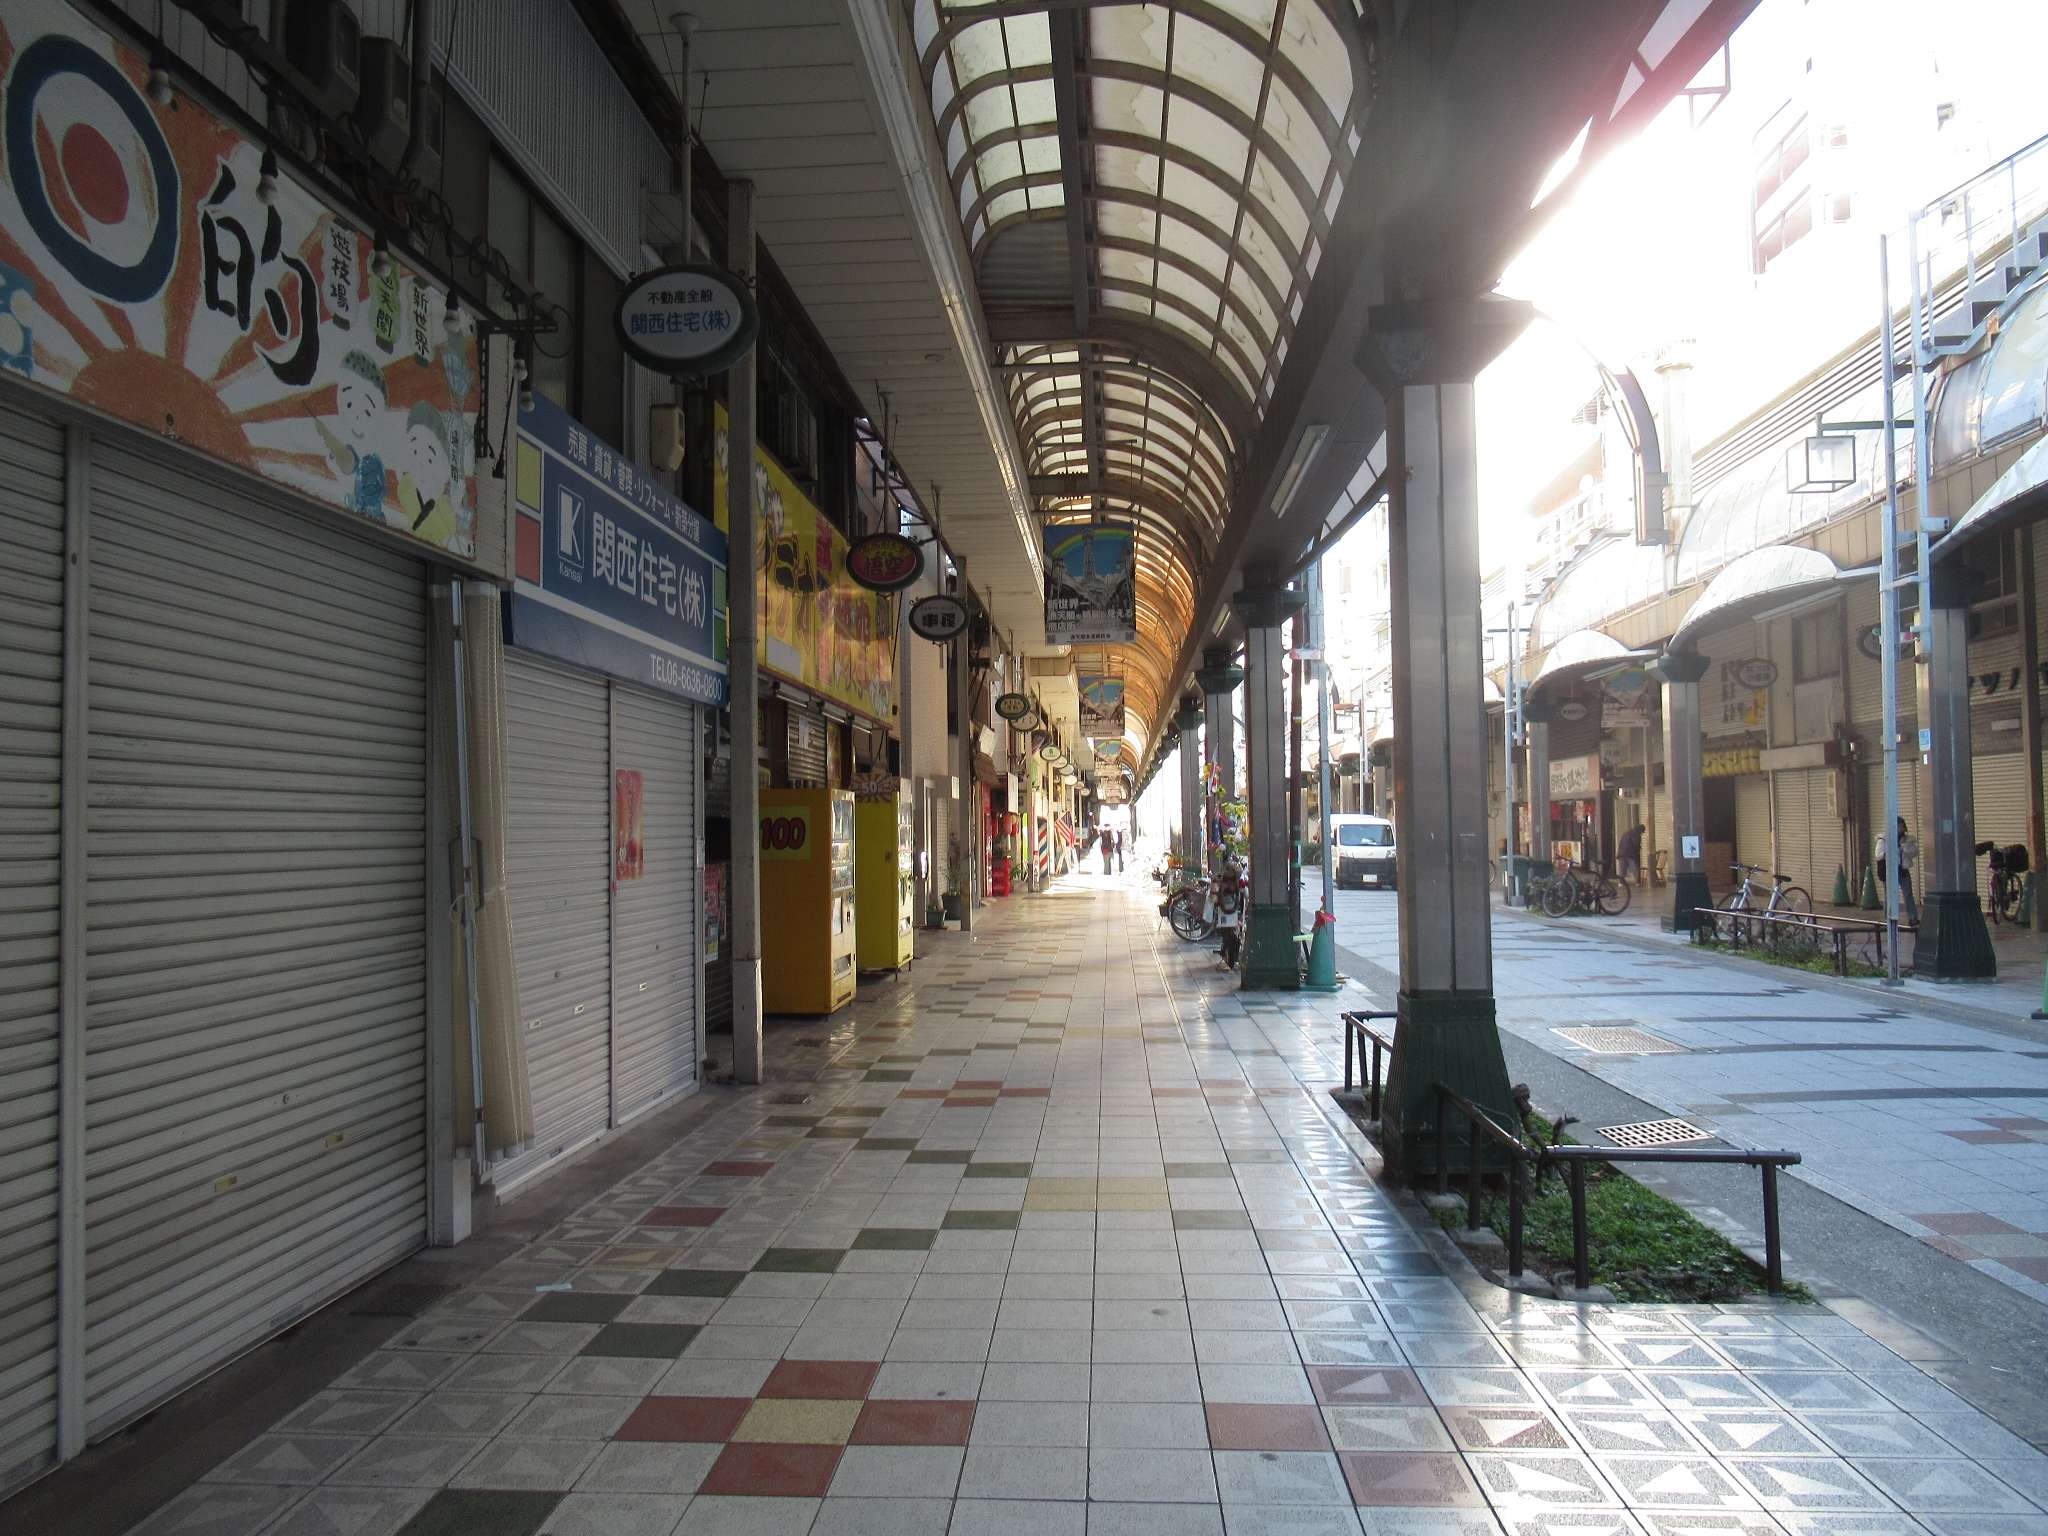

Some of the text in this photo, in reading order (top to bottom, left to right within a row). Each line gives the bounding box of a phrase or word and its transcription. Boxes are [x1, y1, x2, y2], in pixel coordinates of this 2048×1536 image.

[647, 289, 713, 305] 不動産全般
[412, 287, 430, 354] 新世界
[631, 309, 730, 335] 関西住宅(株)
[592, 511, 706, 629] 関西住宅(株)
[761, 816, 806, 850] 100
